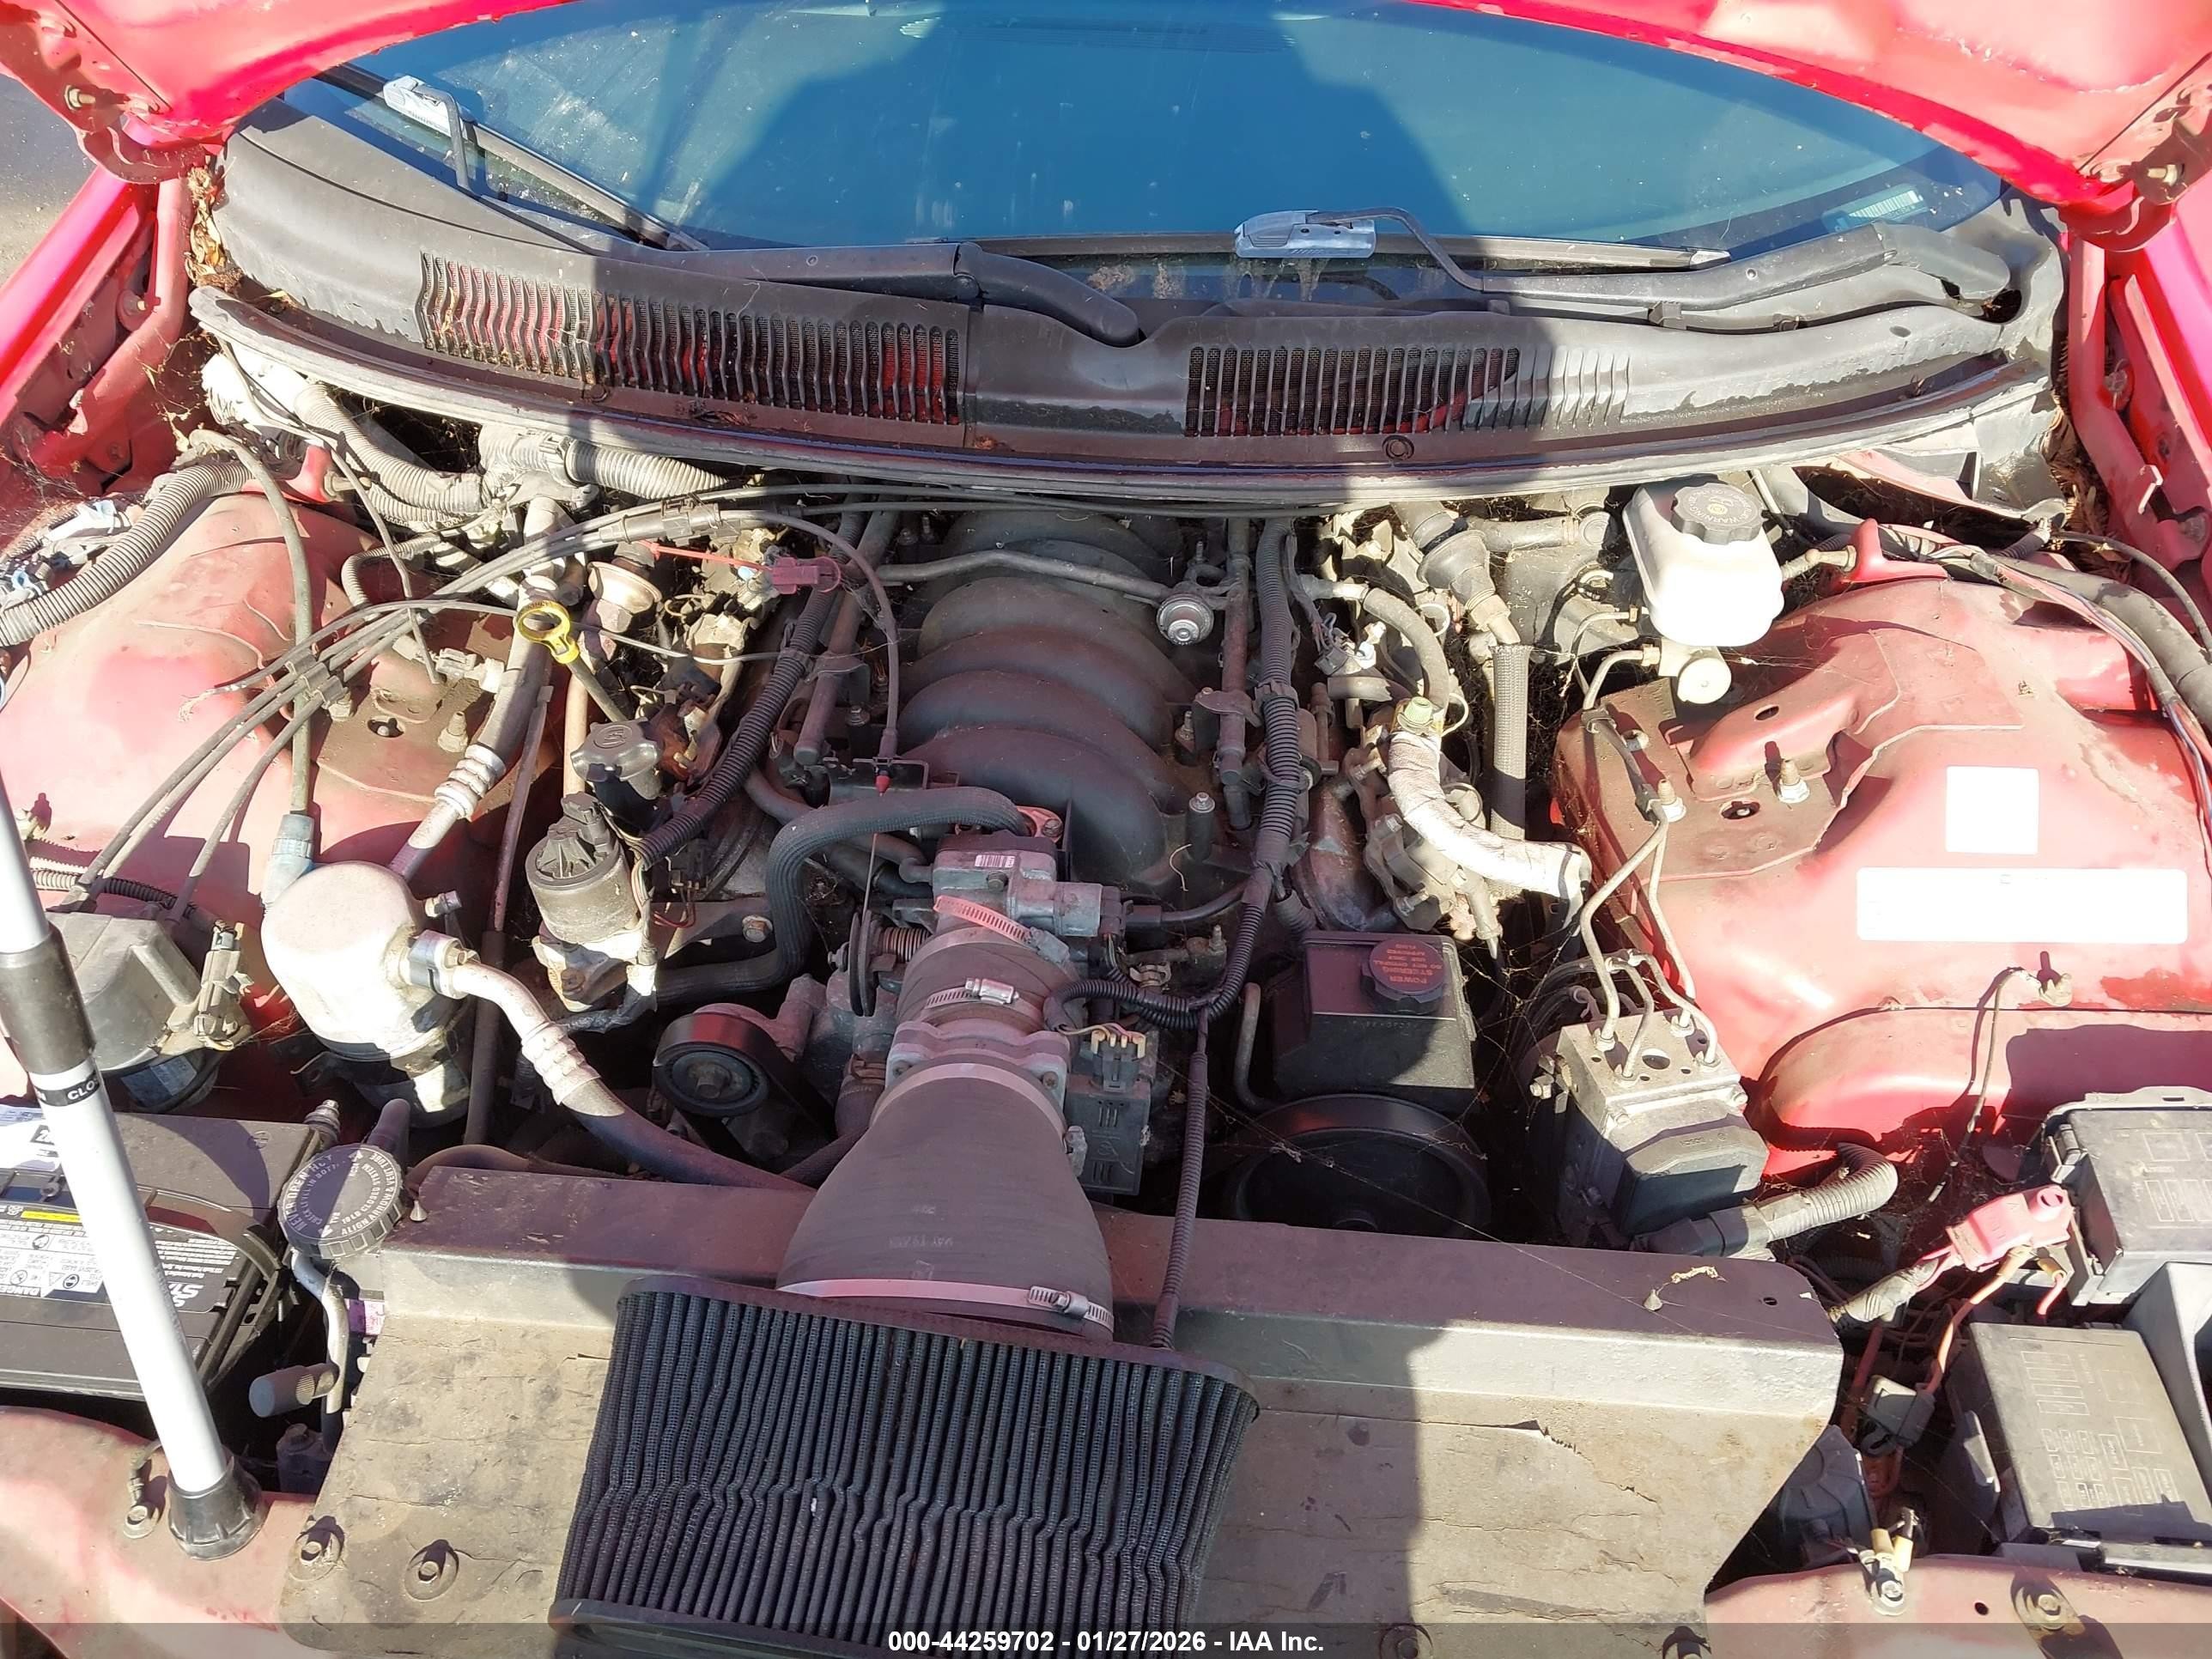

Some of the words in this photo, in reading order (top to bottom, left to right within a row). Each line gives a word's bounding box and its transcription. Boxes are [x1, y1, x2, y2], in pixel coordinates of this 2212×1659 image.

[1382, 965, 1433, 975] STEERING
[1389, 975, 1427, 984] POWER
[288, 1170, 310, 1200] OPEN
[285, 1201, 308, 1231] NEVER
[341, 1218, 369, 1235] ALIGN
[369, 1194, 393, 1220] ARROW
